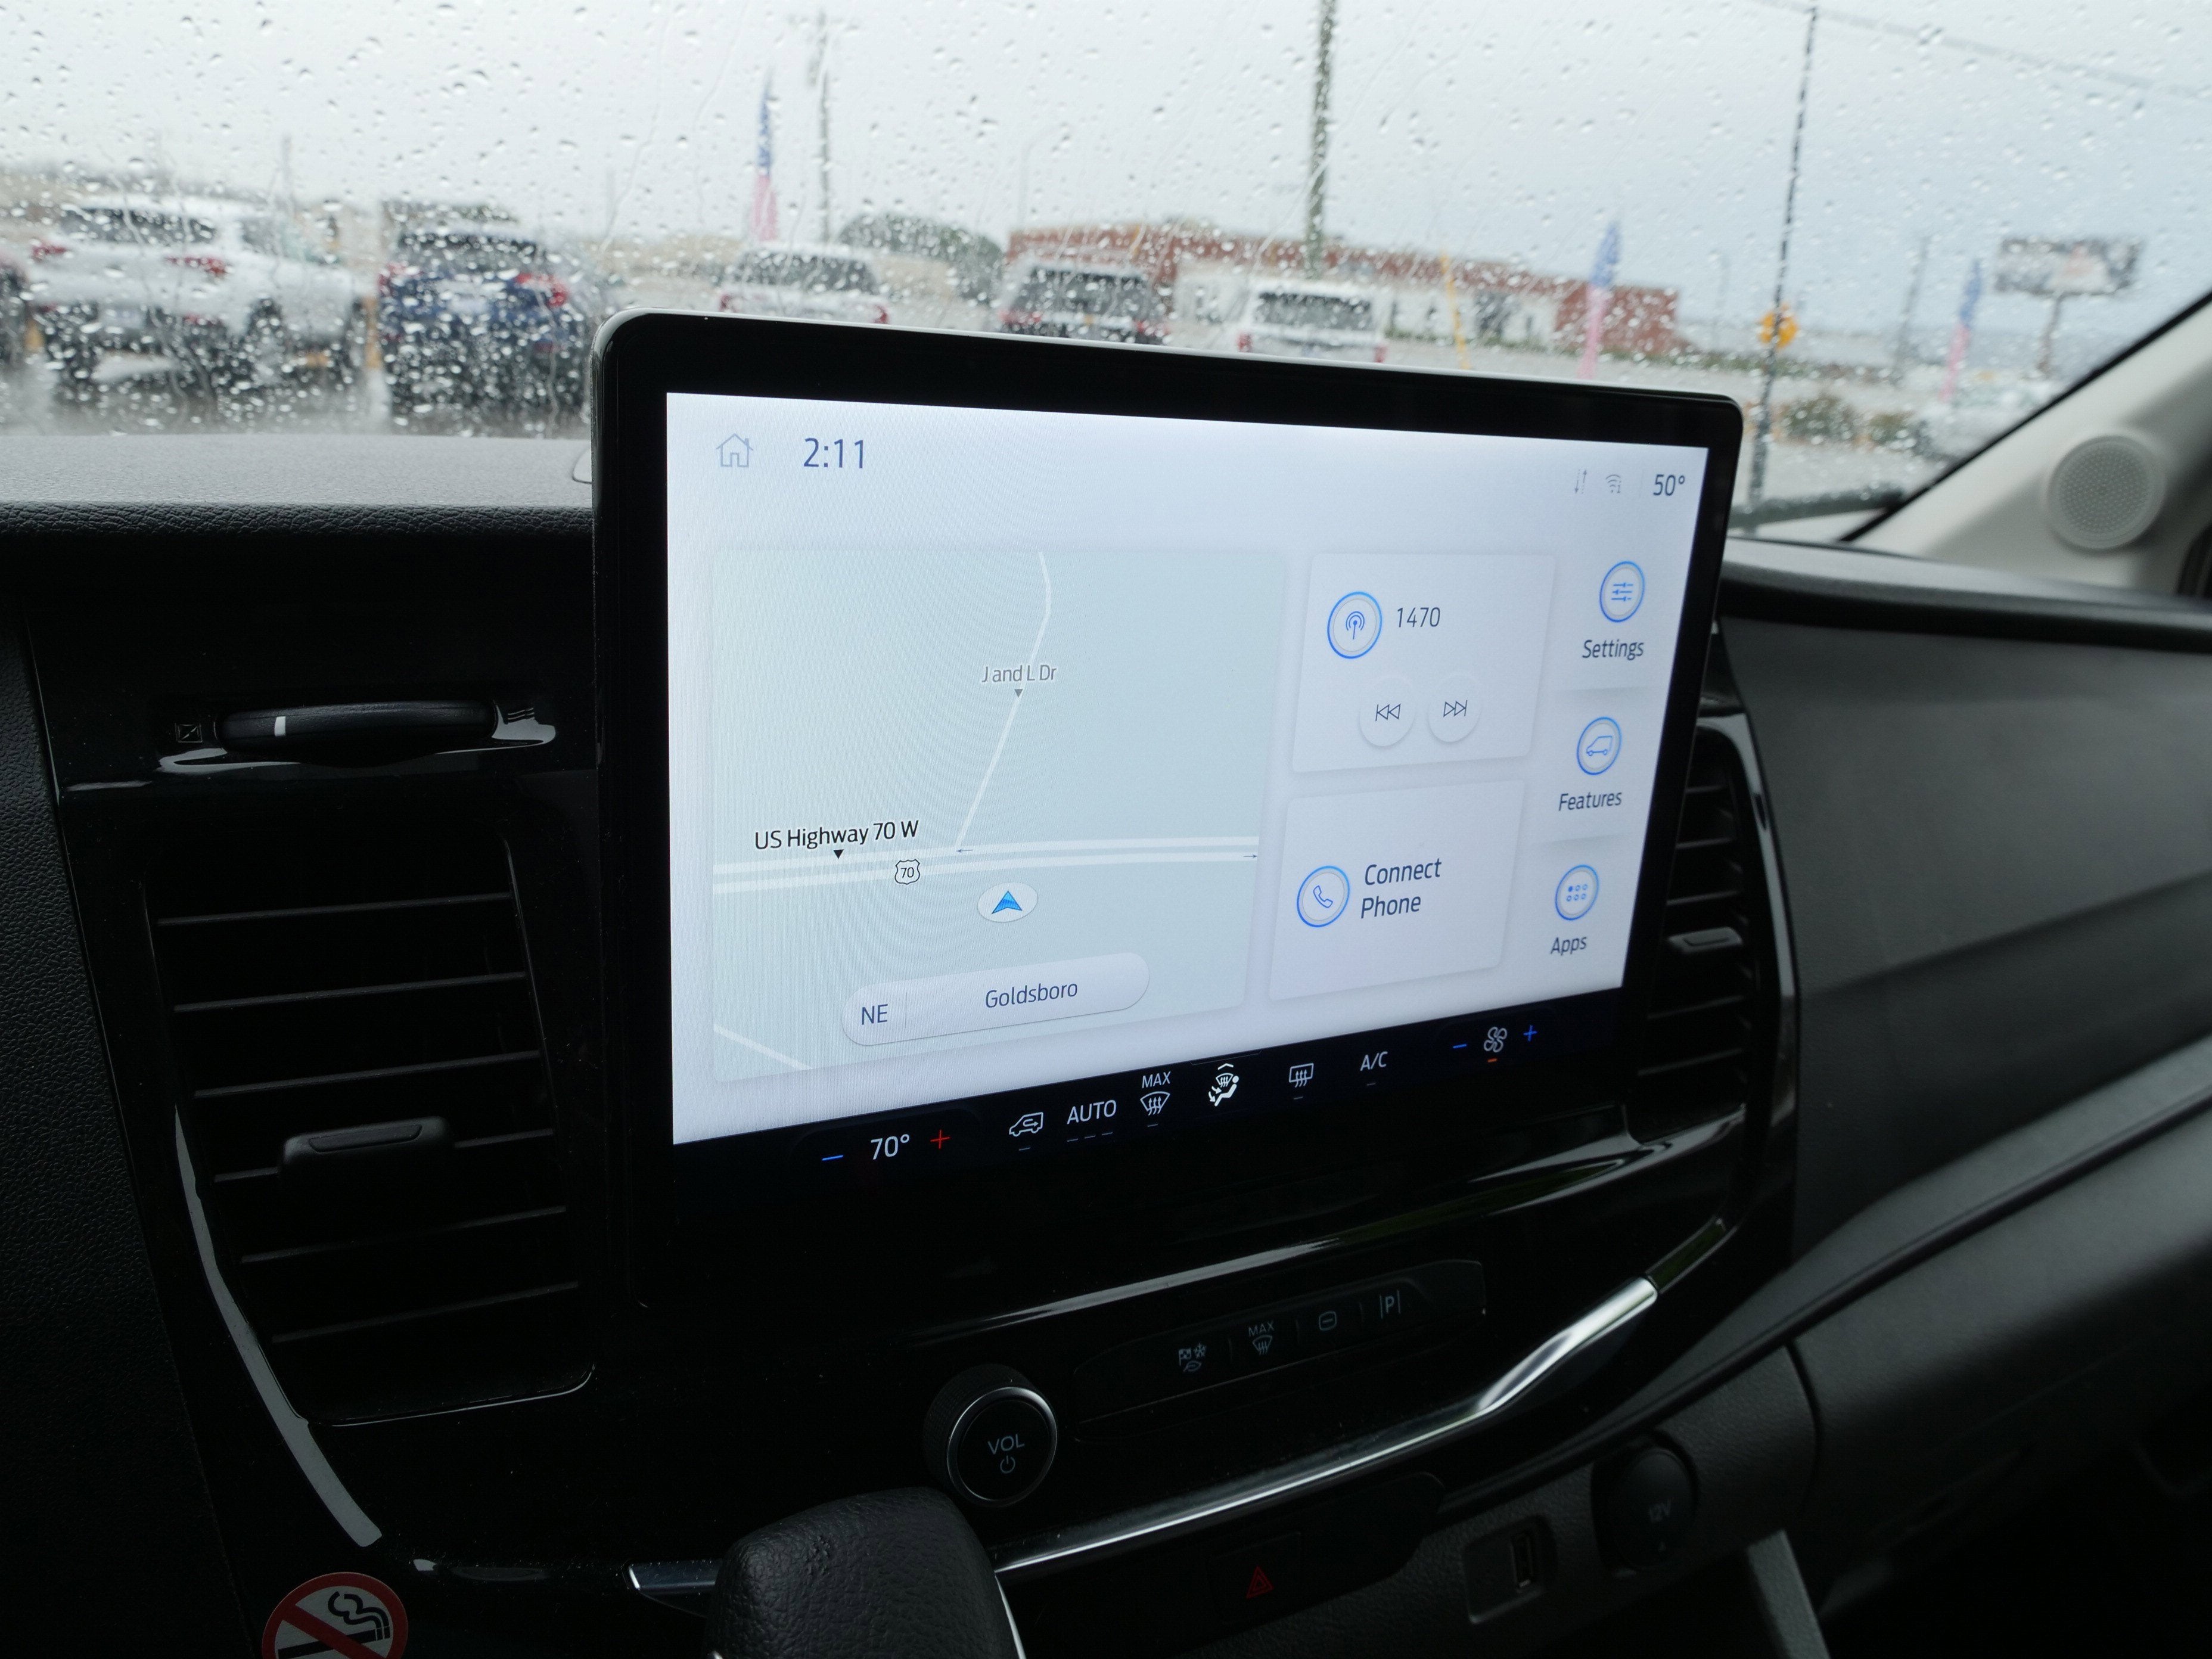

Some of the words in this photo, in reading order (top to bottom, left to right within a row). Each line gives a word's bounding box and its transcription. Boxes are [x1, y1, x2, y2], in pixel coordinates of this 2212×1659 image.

[803, 437, 863, 469] 2:11
[1652, 474, 1685, 496] 50°
[1397, 607, 1441, 628] 1470
[1582, 639, 1644, 661] Settings
[981, 666, 989, 683] J
[992, 664, 1023, 683] and
[1027, 665, 1035, 681] L
[1039, 664, 1057, 681] Dr
[1558, 792, 1622, 811] Features
[755, 830, 782, 850] US
[787, 827, 869, 850] Highway
[873, 821, 896, 840] 70
[900, 820, 919, 838] W
[900, 866, 915, 878] 70
[1365, 858, 1442, 886] Connect
[1360, 896, 1421, 919] Phone
[1551, 936, 1587, 956] Apps
[985, 983, 1078, 1008] Goldsboro
[861, 1004, 888, 1026] NE
[1360, 1051, 1388, 1071] A/C
[1142, 1071, 1171, 1089] MAX
[1067, 1099, 1117, 1124] AUTO
[870, 1133, 910, 1160] 70°
[1385, 1295, 1394, 1313] P
[1248, 1320, 1274, 1337] MAX
[987, 1433, 1025, 1455] VOL
